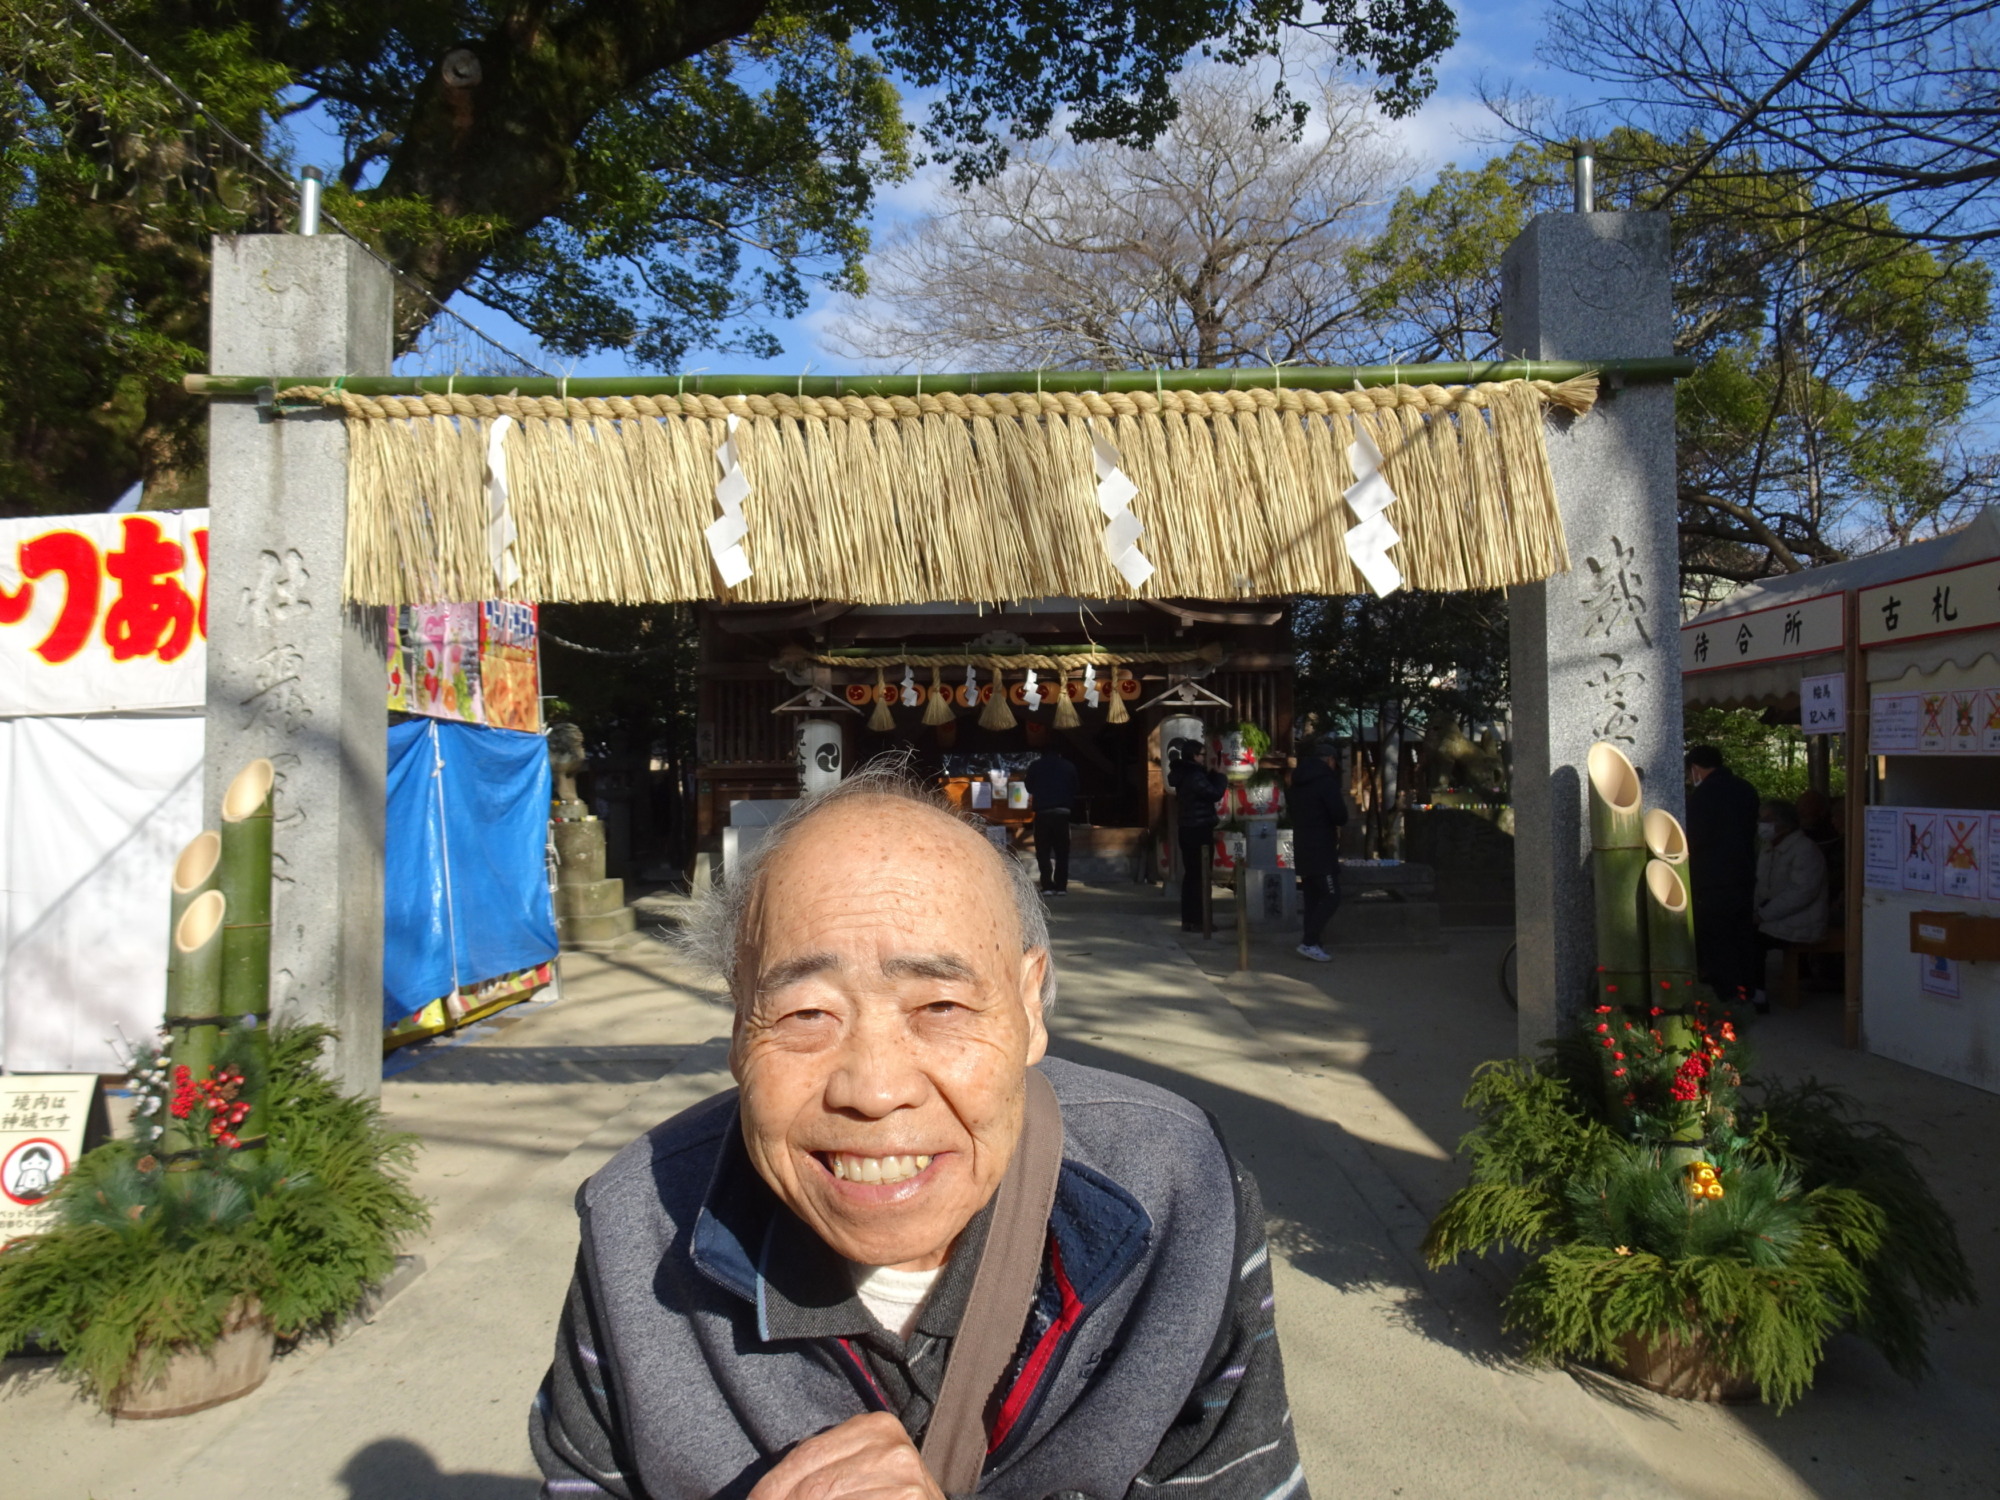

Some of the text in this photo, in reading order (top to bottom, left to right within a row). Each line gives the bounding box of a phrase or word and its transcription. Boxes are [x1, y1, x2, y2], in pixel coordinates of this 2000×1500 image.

[0, 517, 209, 665] つあ
[1882, 584, 2000, 631] 古札
[1694, 610, 1803, 663] 待合所
[1813, 684, 1831, 699] 絵馬
[1810, 708, 1836, 724] 記入所
[12, 1093, 66, 1111] 境内は
[2, 1113, 71, 1129] 神域です
